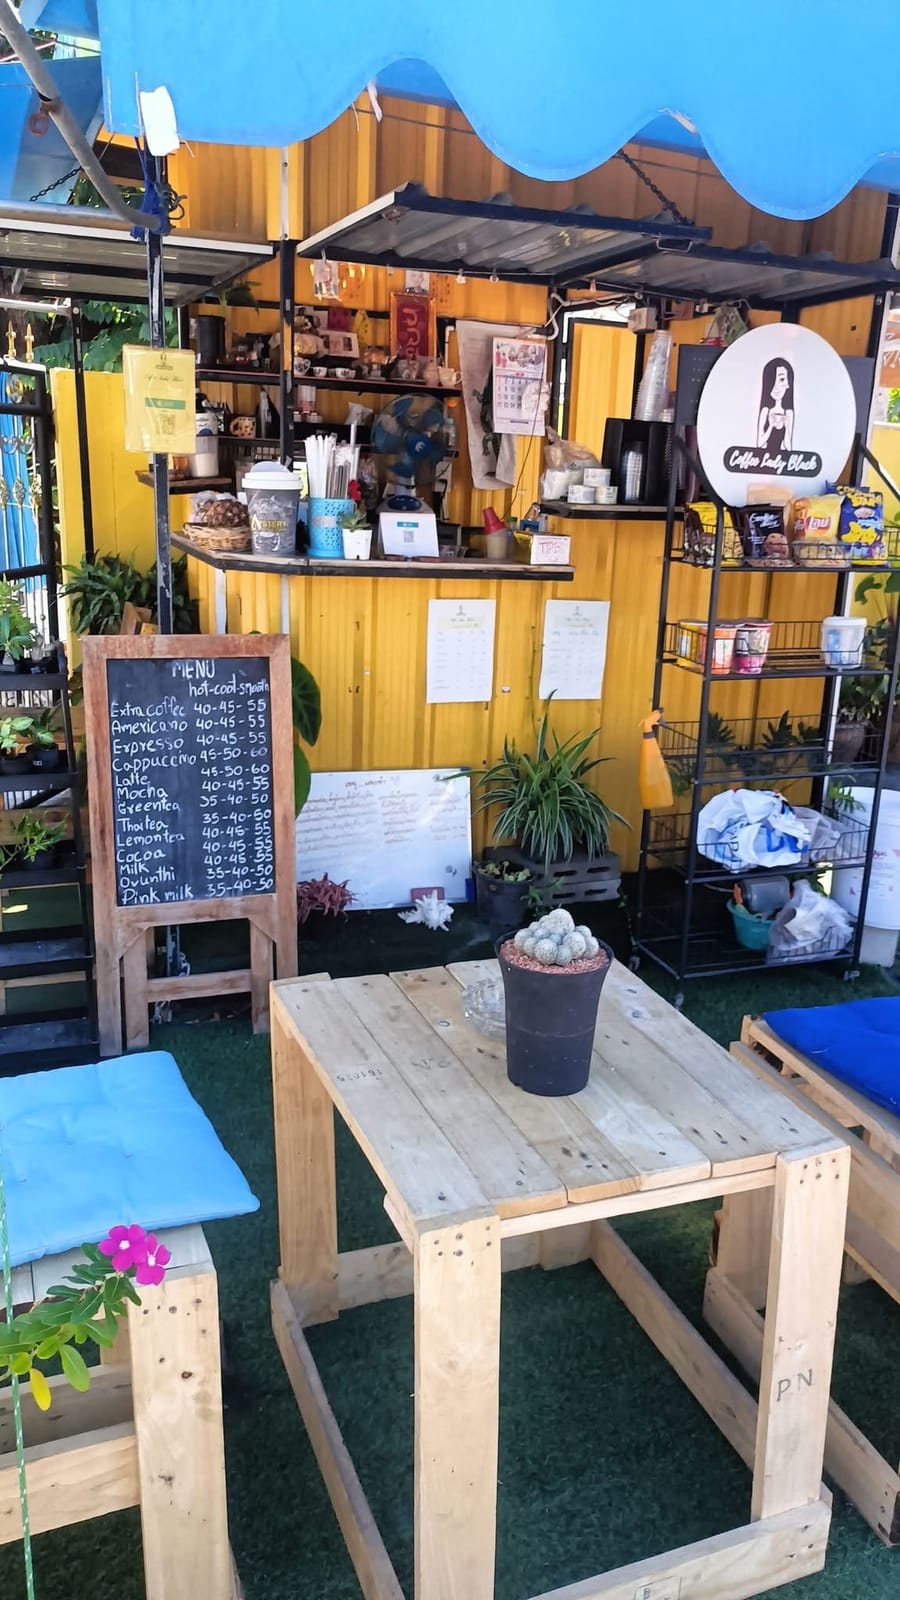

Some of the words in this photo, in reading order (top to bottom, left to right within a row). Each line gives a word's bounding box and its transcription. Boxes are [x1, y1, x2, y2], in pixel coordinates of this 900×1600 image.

[729, 449, 760, 470] Coffee
[760, 452, 787, 475] Lady
[787, 454, 817, 472] Black
[171, 658, 216, 679] MENU
[111, 718, 188, 736] Americano
[111, 749, 197, 773] Cappuccino
[115, 771, 149, 787] Latte
[116, 781, 169, 800] Mocha
[116, 849, 167, 863] Cocoa
[119, 861, 150, 875] Milk
[121, 886, 161, 905] Pink
[164, 884, 194, 901] milk
